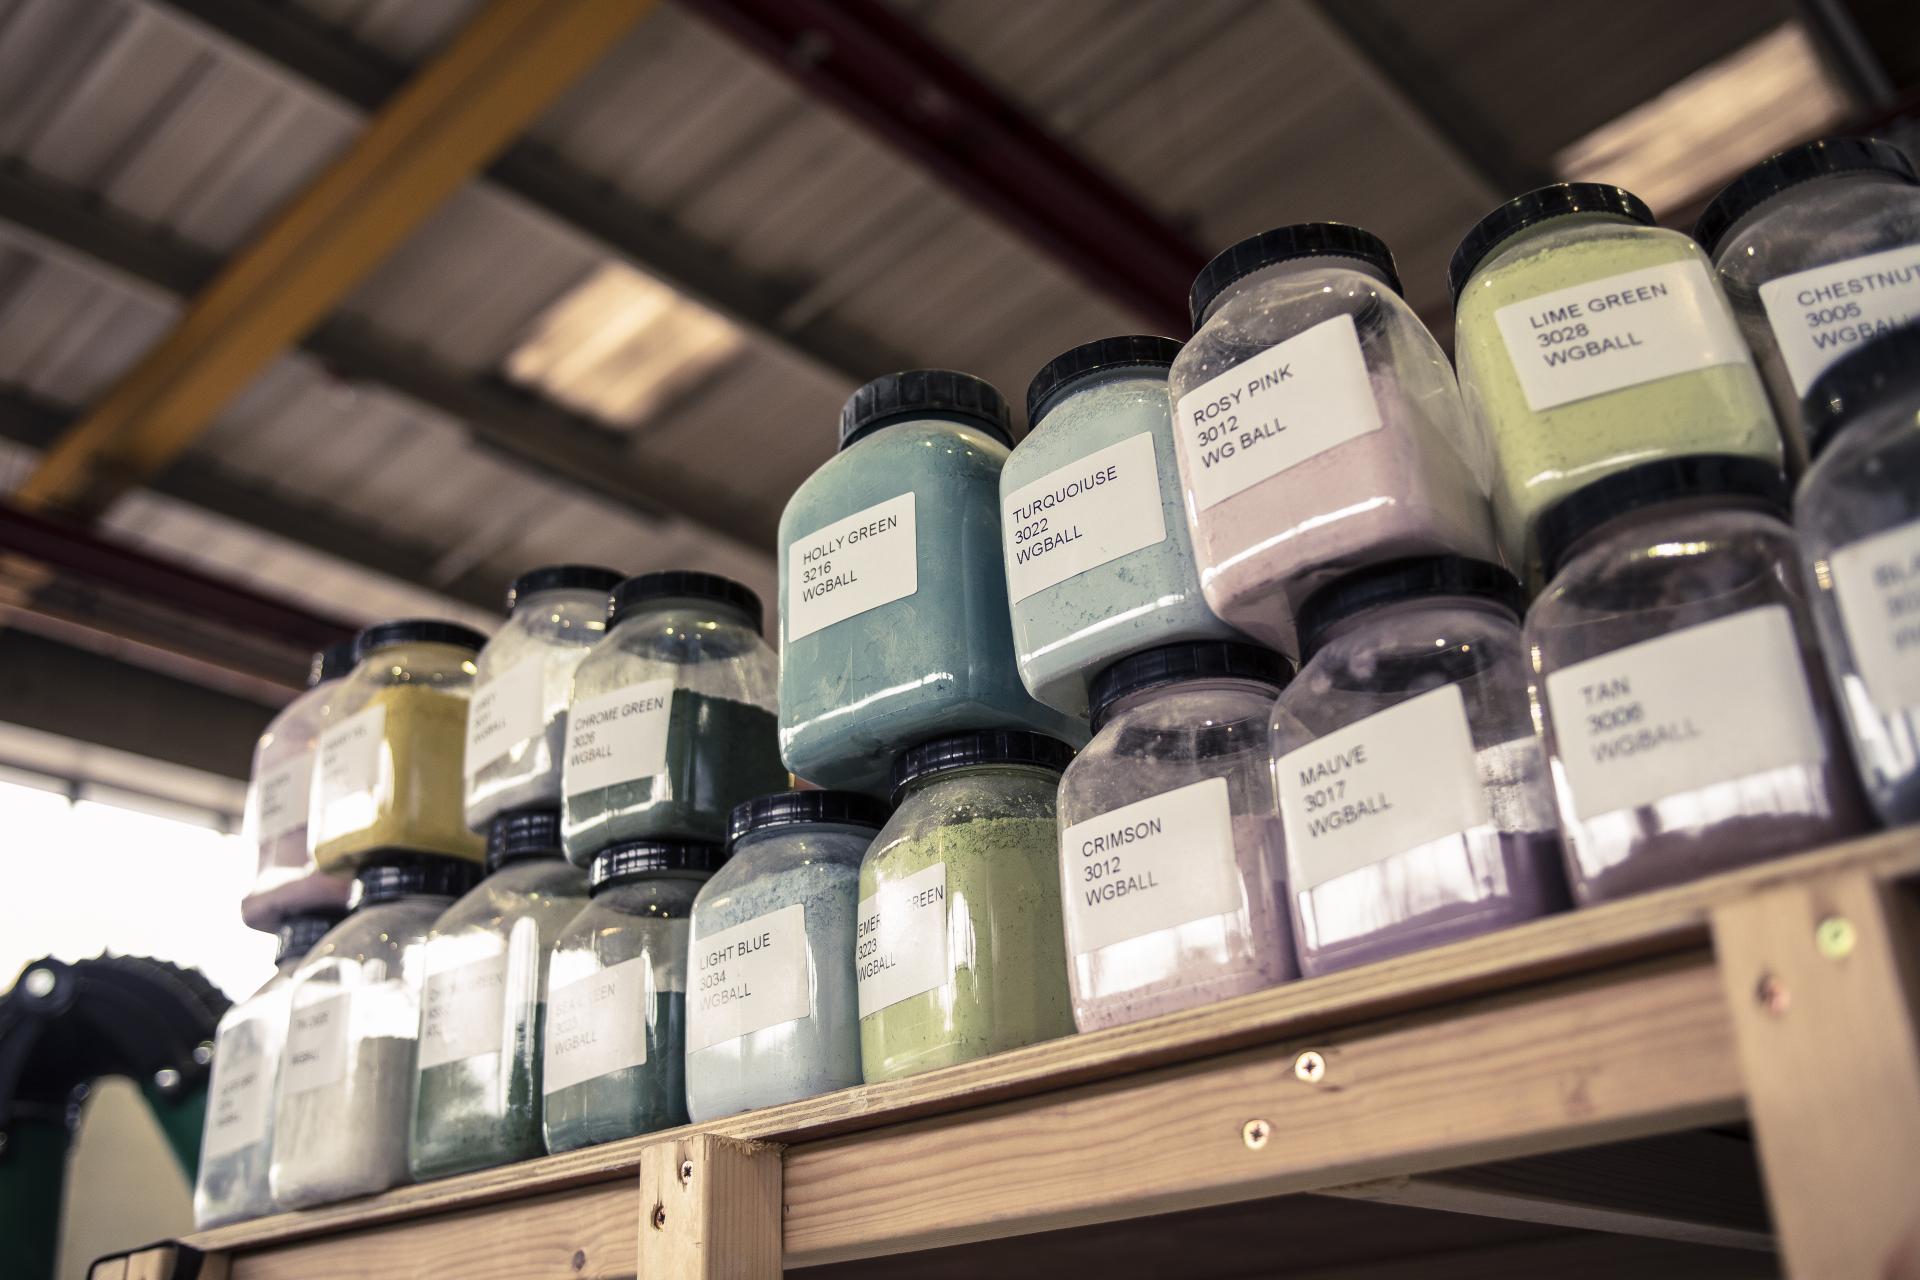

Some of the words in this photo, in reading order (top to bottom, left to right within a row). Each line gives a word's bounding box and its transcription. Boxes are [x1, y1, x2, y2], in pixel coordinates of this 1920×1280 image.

[1529, 303, 1583, 329] LIME
[1587, 283, 1668, 312] GREEN
[1806, 302, 1861, 327] 3005
[1537, 323, 1590, 347] 3028
[1543, 332, 1643, 367] WGBALL
[1193, 388, 1242, 426] ROSY
[1248, 363, 1294, 397] PINK
[1197, 415, 1239, 447] 3012
[1201, 442, 1236, 469] WG
[1240, 418, 1288, 450] BALL
[1012, 465, 1118, 524] TURQUOIUSE
[803, 536, 844, 566] HOLLY
[848, 514, 897, 544] GREEN
[1014, 517, 1049, 545] 3022
[1016, 526, 1083, 565] WGBALL
[802, 560, 832, 584] 3216
[802, 569, 858, 603] WGBALL
[1582, 677, 1632, 706] TAN
[574, 706, 620, 732] CHROME
[621, 696, 665, 718] GREEN
[1299, 744, 1368, 787] MAUVE
[1303, 779, 1346, 813] 3017
[1307, 792, 1393, 838] WGBALL
[1082, 817, 1162, 857] CRIMSON
[1084, 856, 1121, 882] 3012
[1085, 871, 1159, 907] WGBALL
[700, 945, 735, 971] LIGHT
[738, 932, 771, 957] BLUE
[858, 938, 877, 960] 3223
[700, 969, 727, 991] 3034
[700, 983, 752, 1011] WGBALL
[554, 1029, 598, 1056] WGBALL
